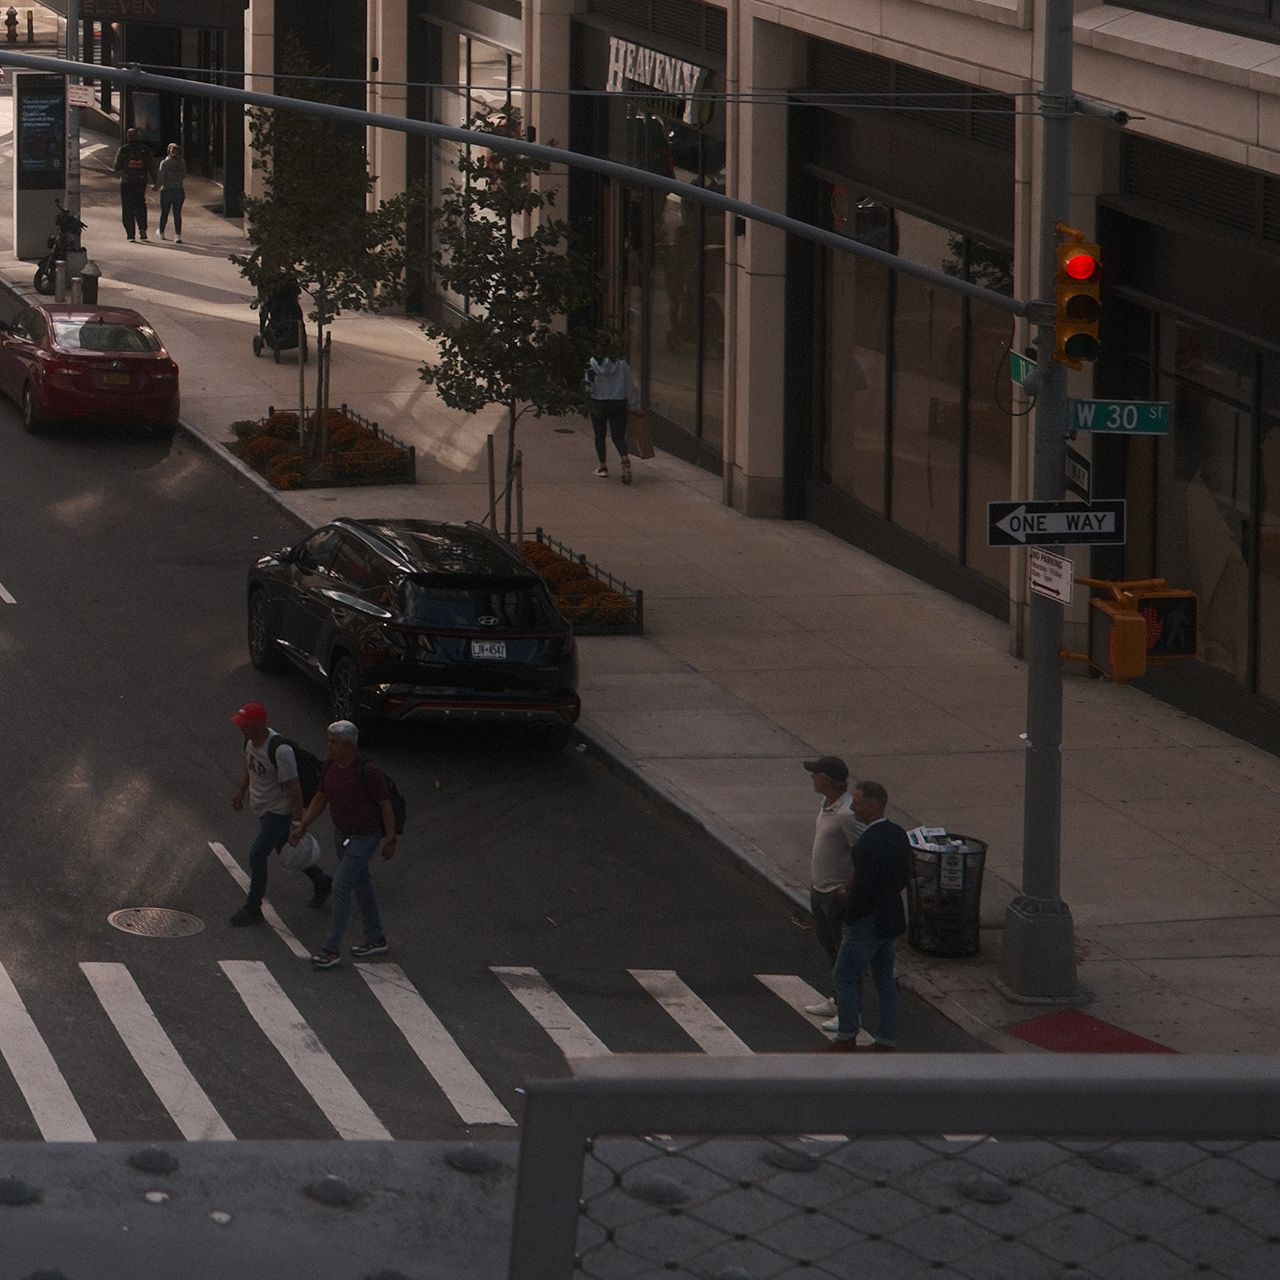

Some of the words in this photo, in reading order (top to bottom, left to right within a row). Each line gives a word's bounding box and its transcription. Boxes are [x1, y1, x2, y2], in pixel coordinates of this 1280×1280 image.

[606, 36, 700, 124] HEAVENLY
[1077, 403, 1096, 428] W
[1106, 404, 1139, 429] 30
[1149, 405, 1165, 419] ST
[1009, 515, 1048, 532] ONE
[1066, 514, 1107, 531] WAY
